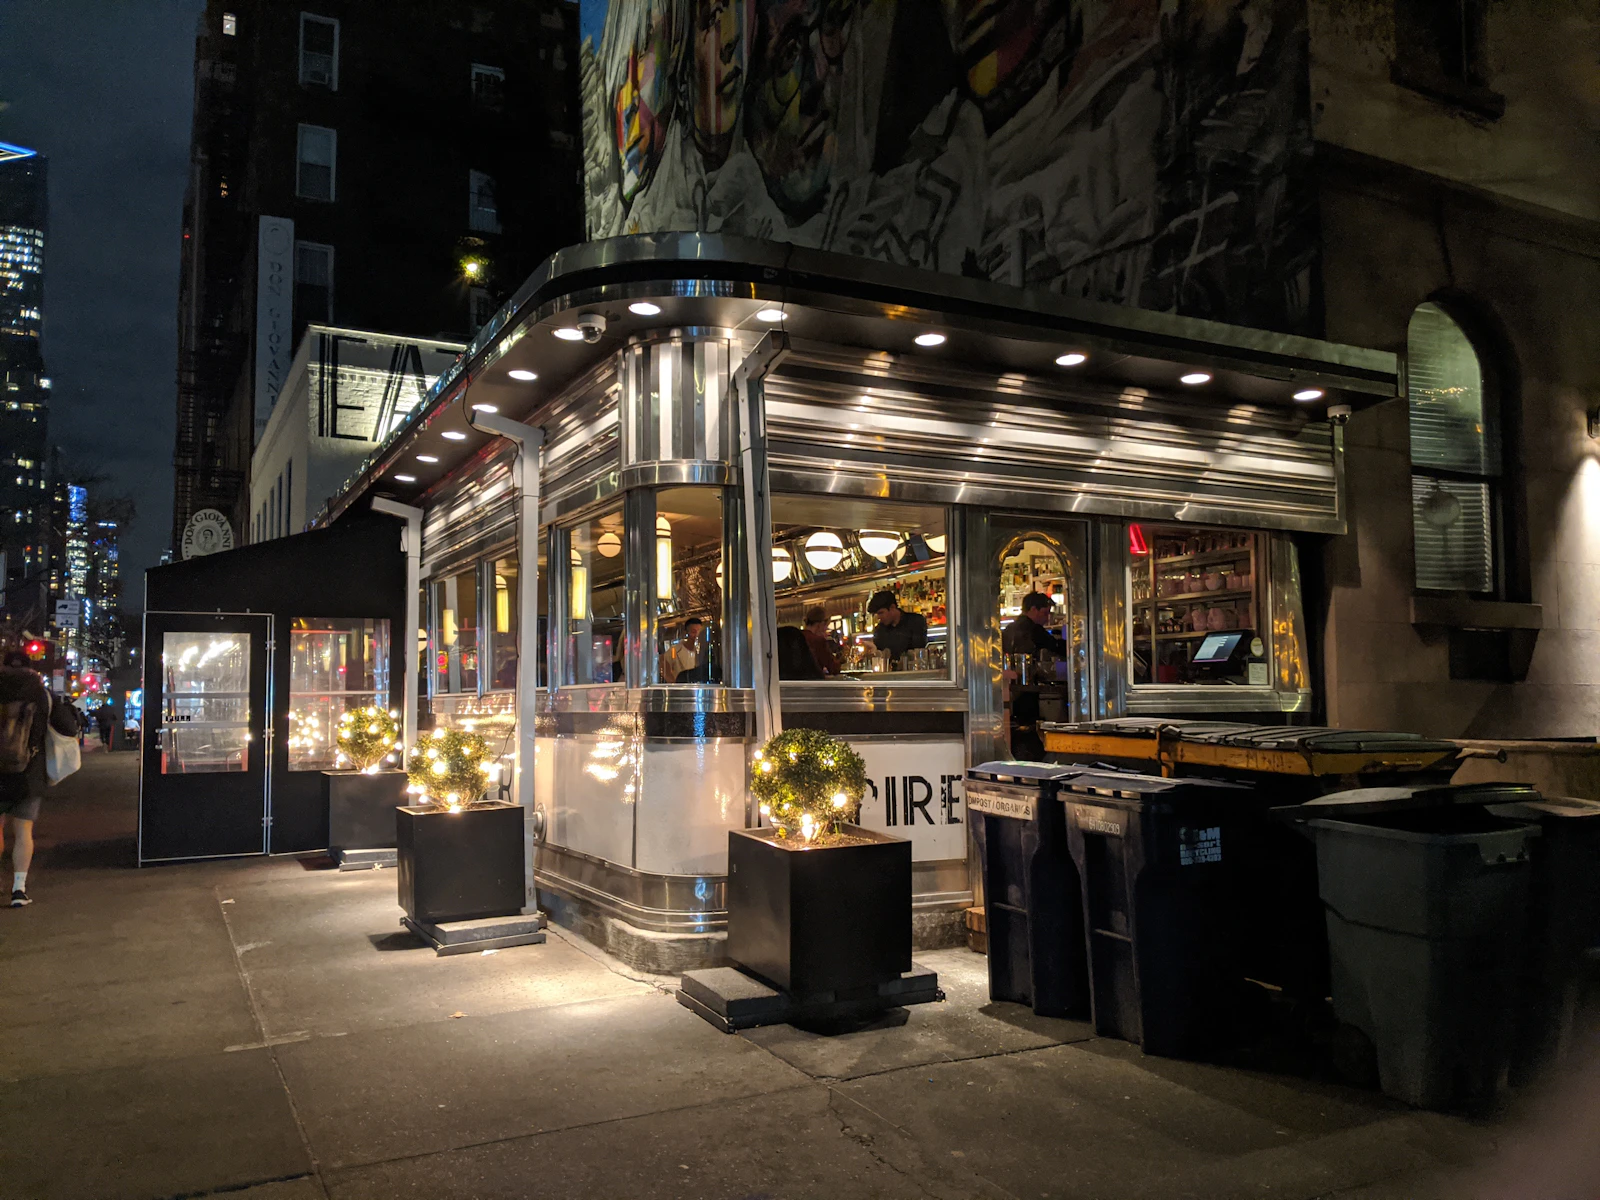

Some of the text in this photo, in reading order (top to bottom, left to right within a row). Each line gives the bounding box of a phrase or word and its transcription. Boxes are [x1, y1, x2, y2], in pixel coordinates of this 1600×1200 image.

[318, 333, 464, 442] EA
[185, 512, 231, 548] DON GIOVANNI
